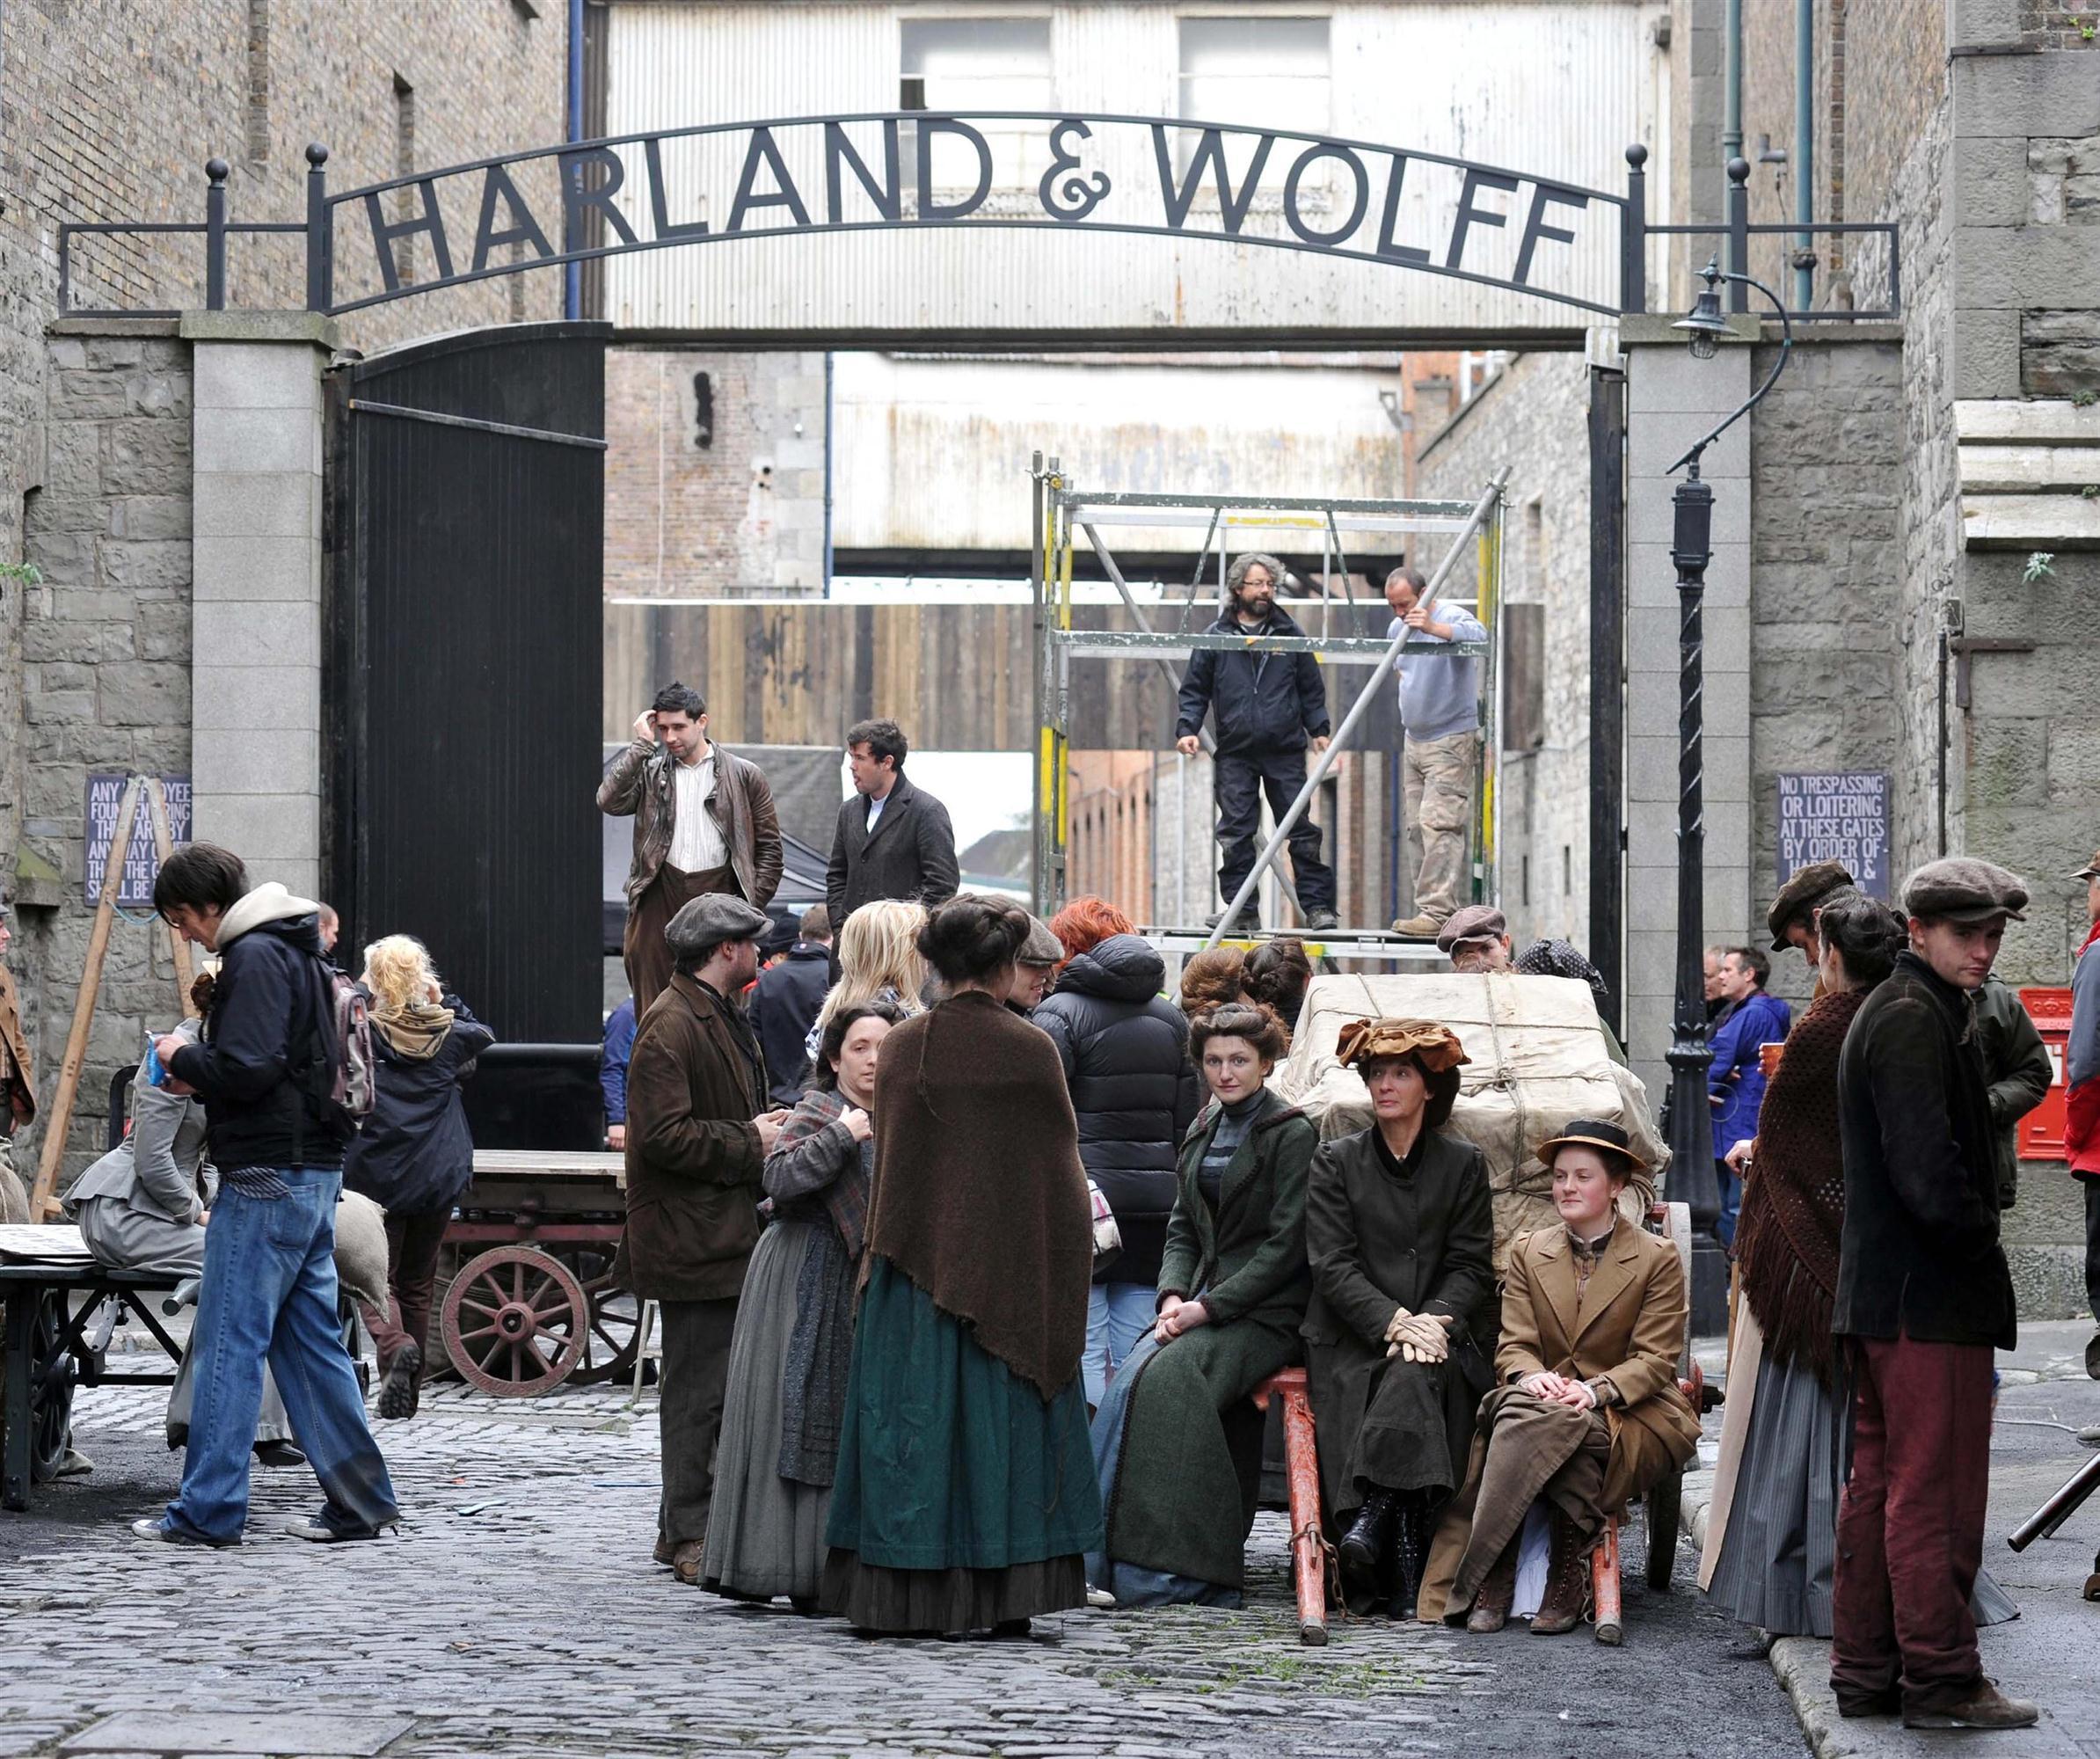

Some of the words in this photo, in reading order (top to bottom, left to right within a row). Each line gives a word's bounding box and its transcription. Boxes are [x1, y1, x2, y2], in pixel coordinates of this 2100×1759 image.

[366, 119, 992, 290] HARLAND
[1038, 120, 1112, 220] &
[1150, 124, 1588, 283] WOLFF
[91, 782, 120, 801] ANY
[1780, 776, 1798, 794] NO
[1800, 775, 1885, 794] TRESPASSING
[1782, 796, 1804, 818] OR
[1807, 795, 1882, 817] LOITERING
[1780, 818, 1797, 838] AT
[1799, 818, 1840, 837] THESE
[1841, 818, 1885, 837] GATES
[126, 841, 149, 859] AY
[1783, 838, 1805, 859] BY
[1809, 838, 1858, 858] ORDER
[1862, 837, 1882, 858] OF
[125, 861, 149, 880] THE
[1863, 859, 1877, 880] &
[133, 881, 150, 900] BE
